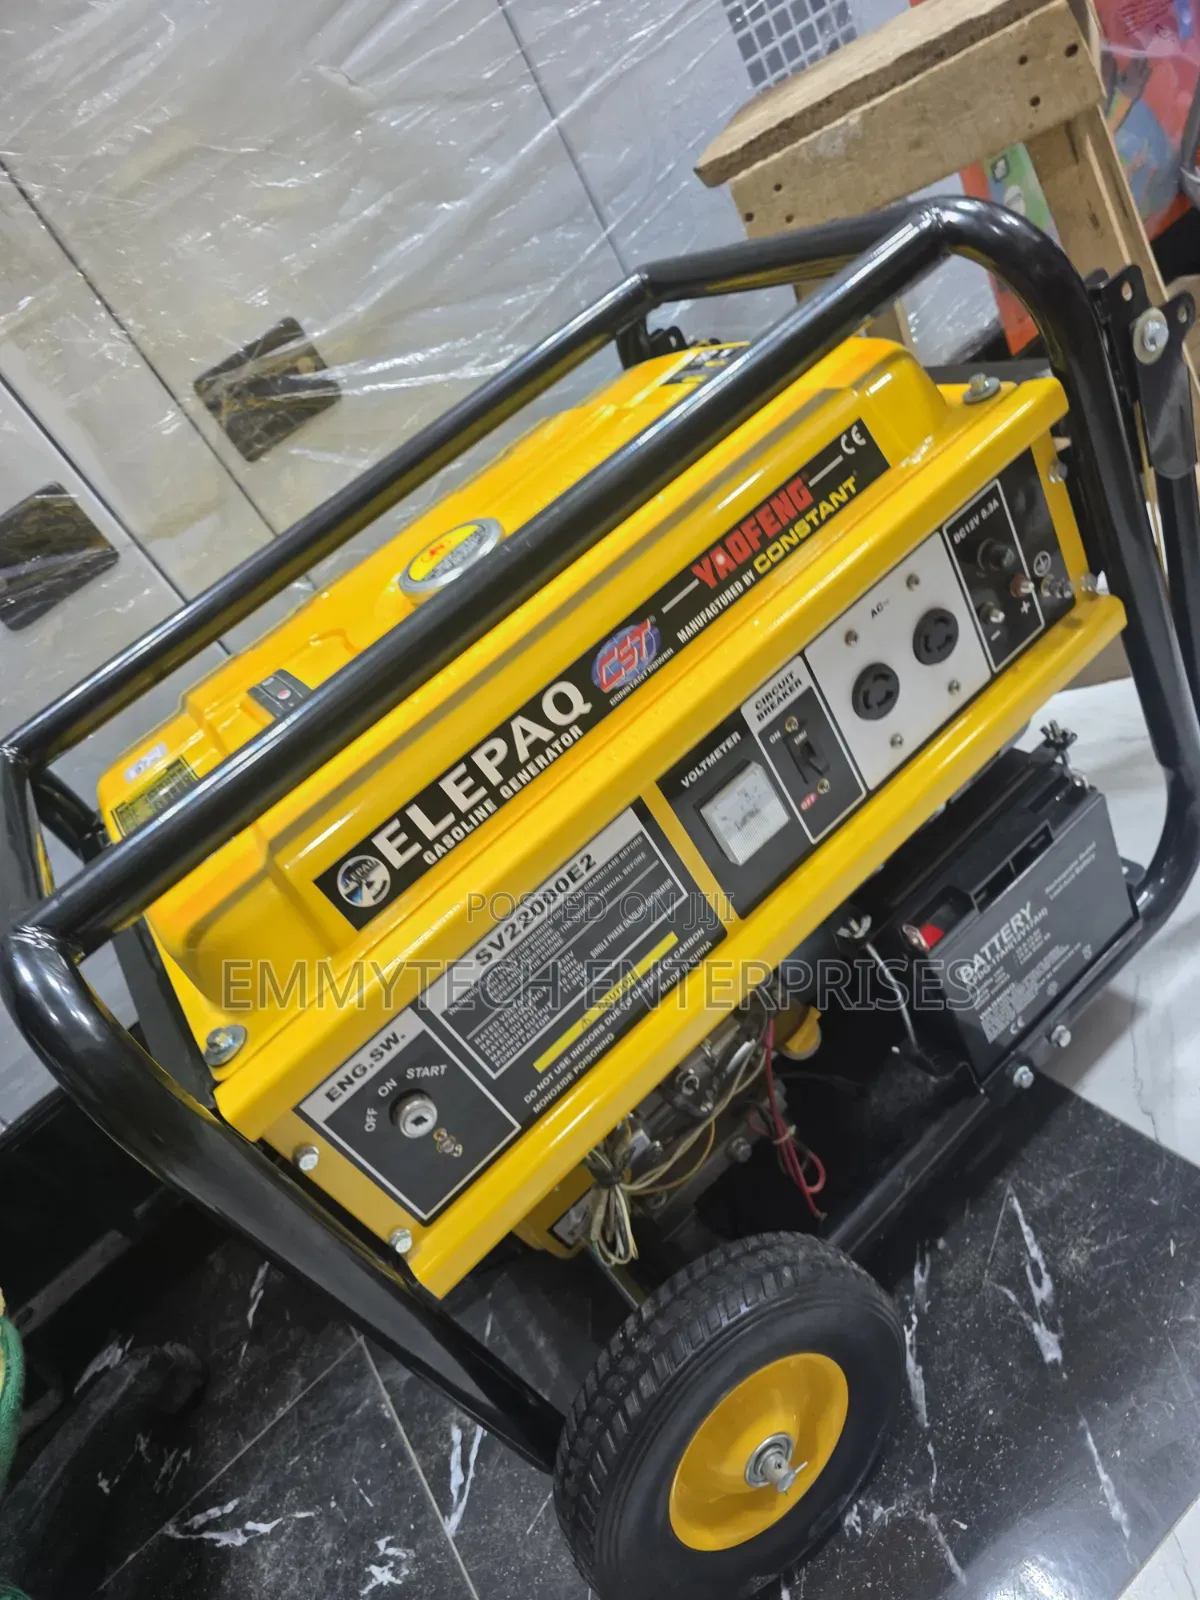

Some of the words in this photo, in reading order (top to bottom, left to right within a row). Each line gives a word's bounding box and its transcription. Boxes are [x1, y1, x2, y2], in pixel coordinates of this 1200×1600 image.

[692, 478, 812, 587] YAOFENG
[676, 580, 743, 643] MANUFACTURED
[741, 569, 755, 586] BY
[753, 475, 856, 574] CONSTANT
[592, 617, 654, 694] CST
[609, 668, 647, 705] CONSTANT
[755, 672, 793, 710] CIRCUIT
[756, 678, 802, 721] BREAKER
[680, 731, 741, 787] VOLTMETER
[769, 730, 781, 744] ON
[371, 680, 592, 869] ELEPAQ
[422, 798, 497, 864] GASOLINE
[499, 724, 583, 799] GENERATOR
[618, 835, 642, 859] BEFORE
[597, 874, 623, 897] MANUAL
[622, 851, 646, 875] BEFORE
[475, 853, 596, 966] SV22000E2
[589, 938, 609, 958] SINGLE
[606, 923, 625, 942] PHASE
[658, 967, 680, 991] MADE
[680, 959, 690, 971] IN
[688, 940, 711, 963] CHINA
[956, 900, 1032, 983] BATTERY
[474, 1020, 499, 1044] RATED
[479, 1026, 504, 1050] RATED
[484, 1032, 509, 1056] RATED
[509, 1004, 537, 1033] OUTPUT
[490, 1027, 524, 1061] MAXIMUM
[523, 1000, 552, 1029] OUTPUT
[494, 1040, 522, 1067] POWER
[521, 1014, 550, 1042] FACTOR
[523, 1089, 537, 1103] DO
[536, 1072, 553, 1091] NOT
[553, 1056, 571, 1074] USE
[569, 1023, 605, 1059] INDOORS
[604, 1007, 621, 1025] DUE
[631, 965, 663, 999] DANGER
[662, 957, 673, 969] OF
[673, 927, 704, 959] CARBON
[324, 1031, 405, 1102] ENG.SW.
[377, 1077, 397, 1096] ON
[405, 1064, 447, 1079] START
[532, 1071, 573, 1113] MONOXIDE
[572, 1032, 614, 1074] POISONING
[364, 1107, 377, 1132] OFF
